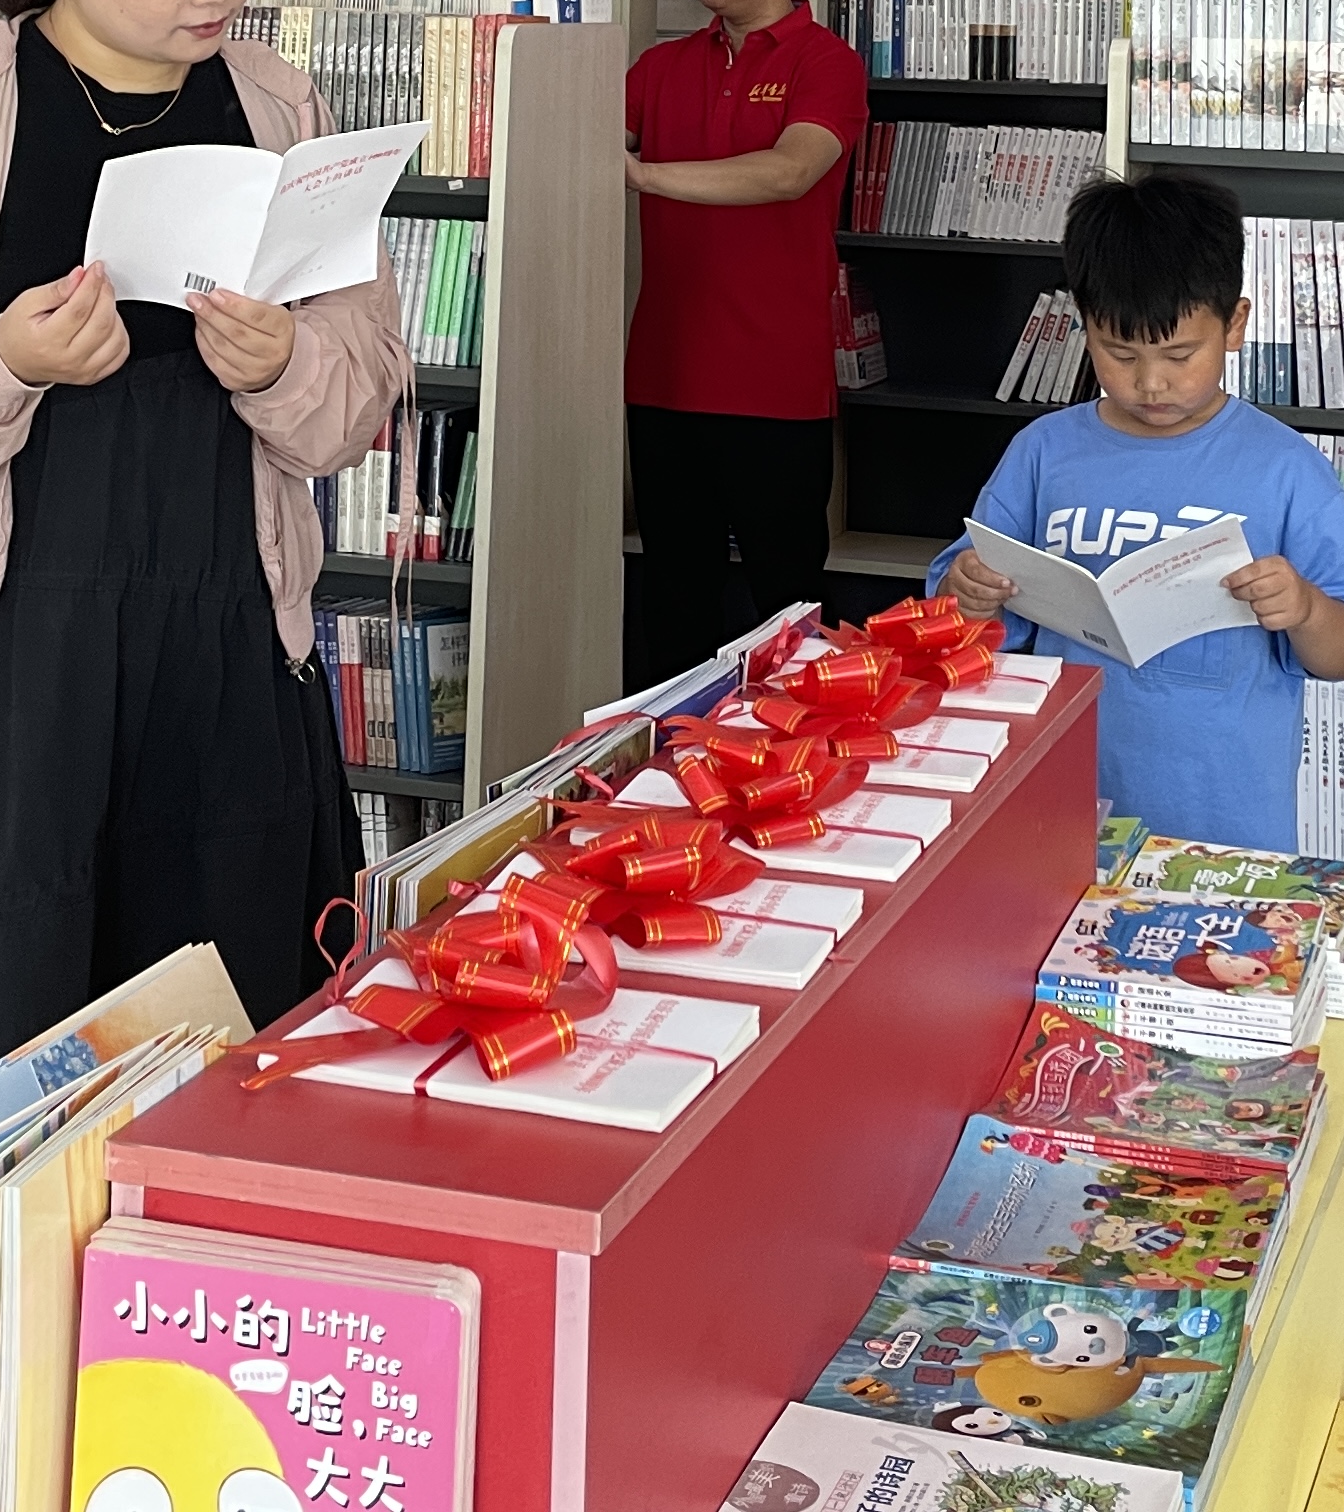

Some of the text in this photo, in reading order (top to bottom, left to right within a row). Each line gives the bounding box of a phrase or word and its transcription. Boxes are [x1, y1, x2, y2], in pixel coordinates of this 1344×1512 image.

[114, 1281, 290, 1356] 小小的
[301, 1307, 387, 1345] Little
[346, 1347, 403, 1377] Face
[371, 1381, 419, 1420] Big
[375, 1417, 433, 1449] Face
[305, 1447, 406, 1512] 大大
